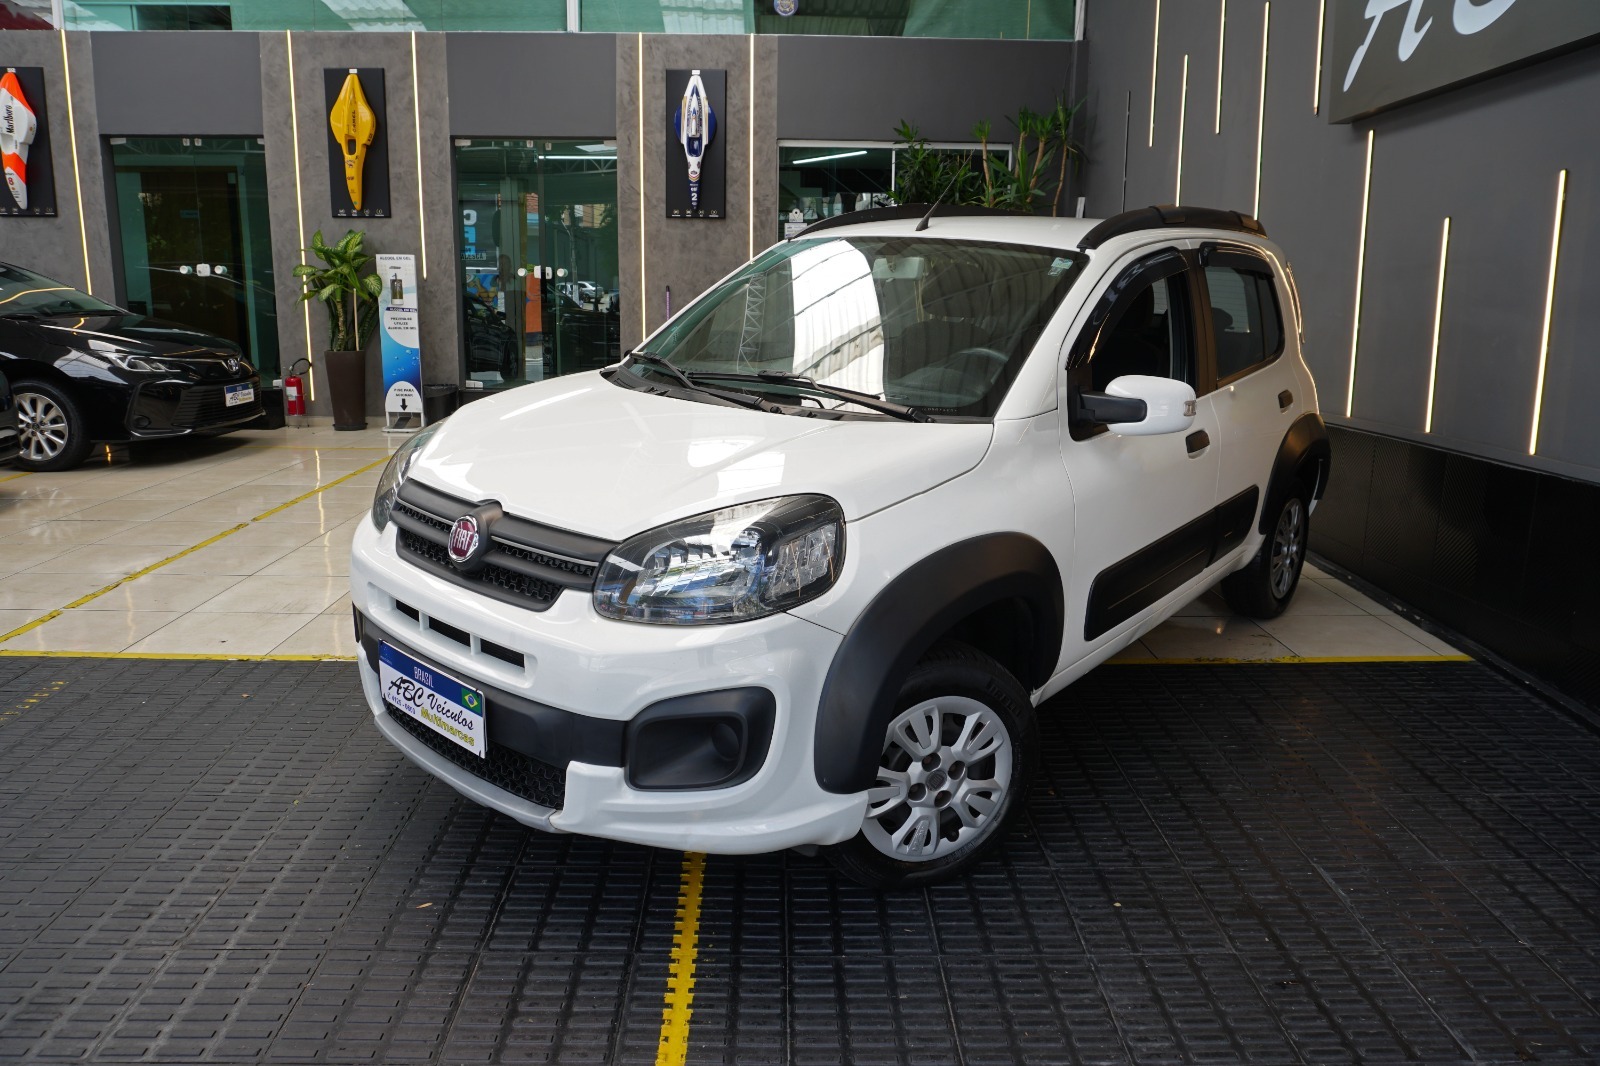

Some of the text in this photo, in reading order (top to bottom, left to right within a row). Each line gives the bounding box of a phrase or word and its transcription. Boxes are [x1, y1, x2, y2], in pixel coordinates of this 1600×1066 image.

[3, 104, 14, 134] Marlboro
[691, 192, 698, 201] 2
[453, 528, 473, 551] FIAT
[413, 666, 434, 688] BRASIL
[388, 676, 424, 708] ABC
[420, 706, 475, 747] Multimarcas
